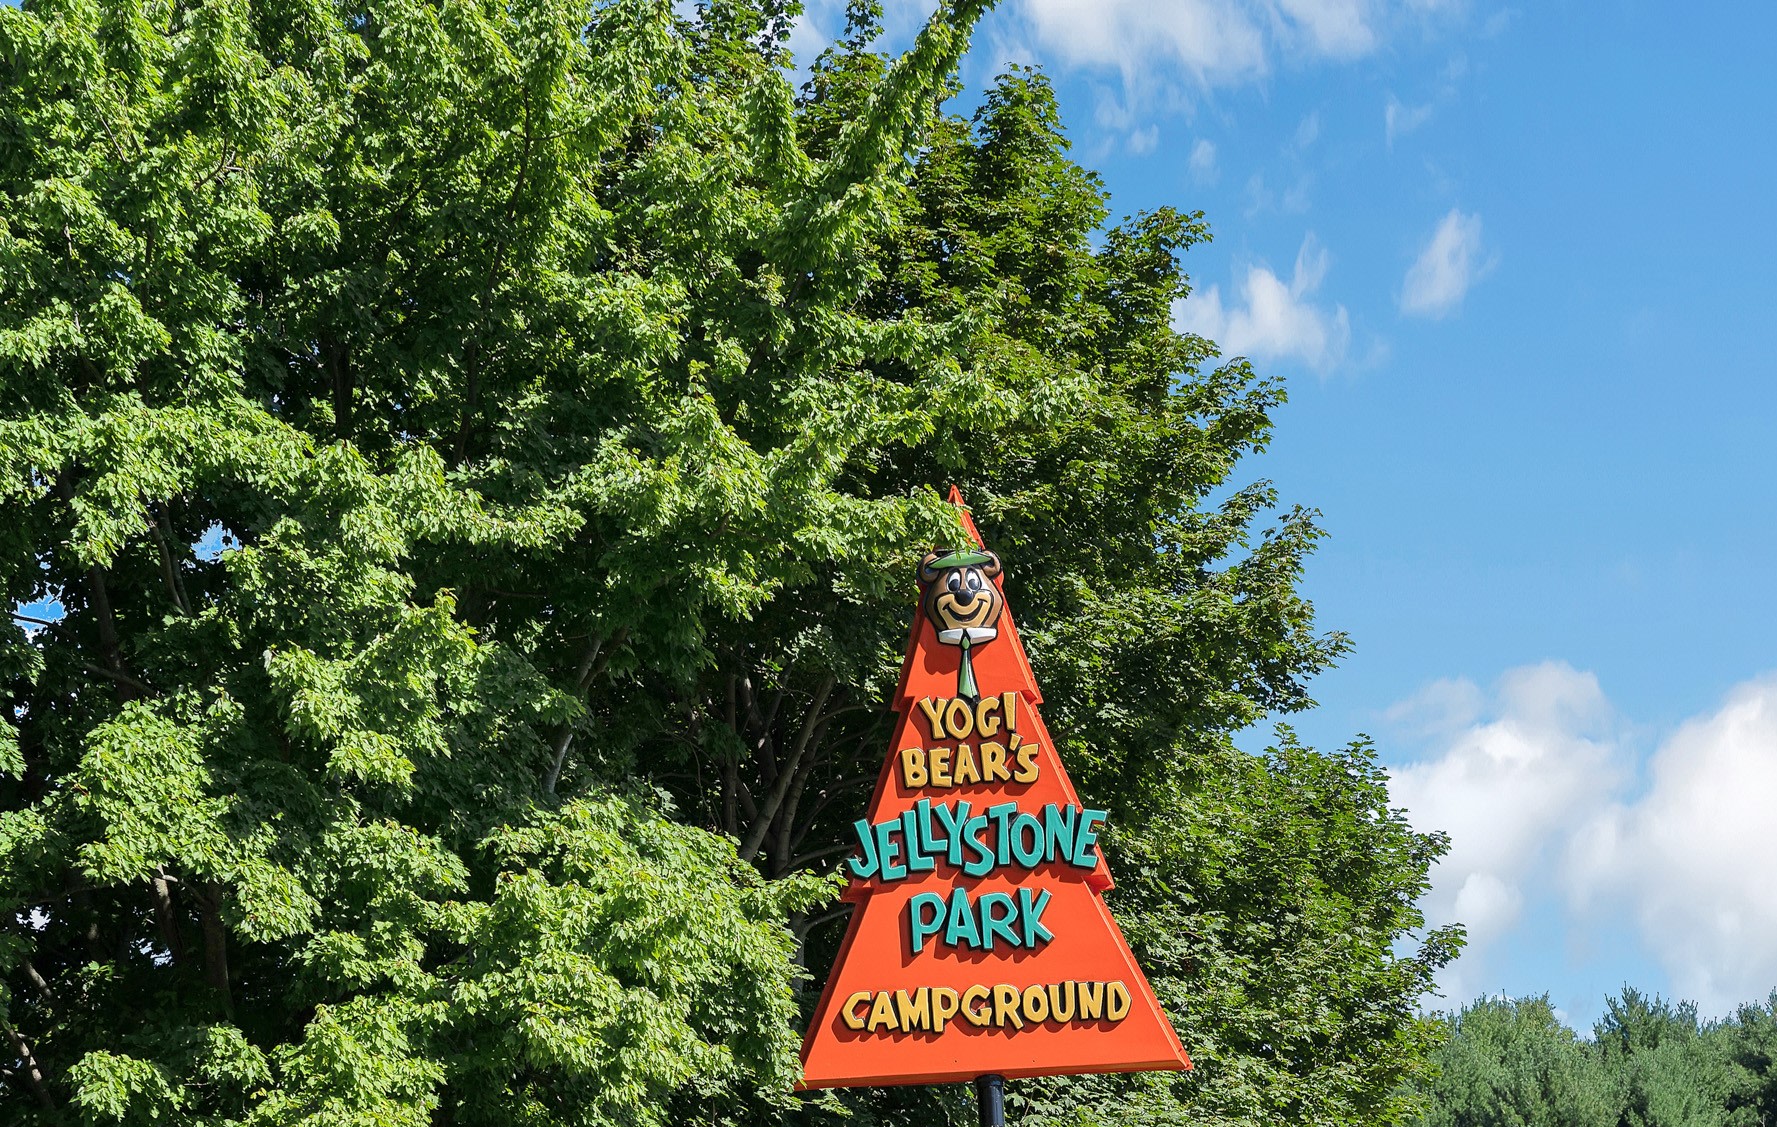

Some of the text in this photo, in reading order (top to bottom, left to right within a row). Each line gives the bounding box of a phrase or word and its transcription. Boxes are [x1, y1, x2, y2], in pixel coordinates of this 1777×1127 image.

[918, 691, 1018, 740] YOGI
[901, 733, 1041, 788] BEAR'S
[847, 798, 1107, 881] JELLYSTONE
[911, 888, 1053, 953] PARK
[841, 980, 1132, 1033] CAMPGROUND
